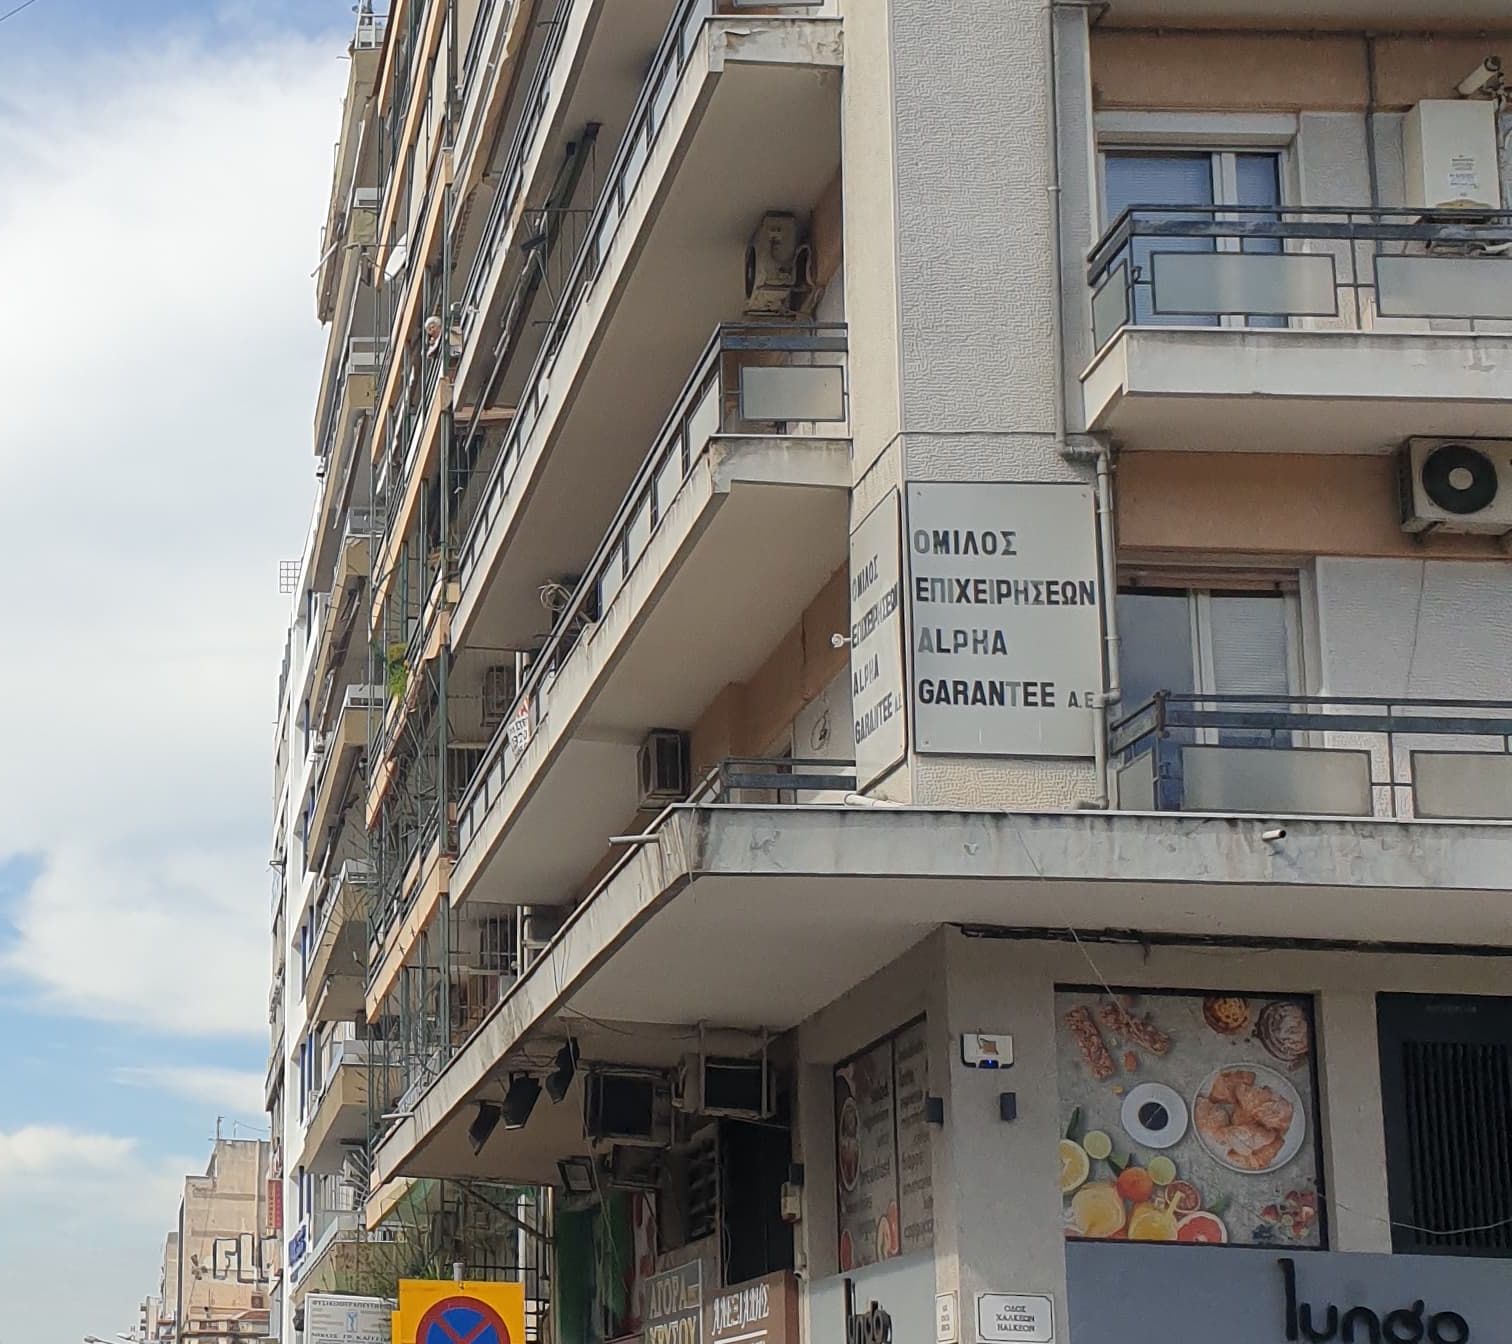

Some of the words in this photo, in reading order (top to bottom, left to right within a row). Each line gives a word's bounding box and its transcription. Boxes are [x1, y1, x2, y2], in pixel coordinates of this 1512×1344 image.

[913, 529, 1018, 556] ΟΜΙΛΟΣ
[915, 576, 1096, 606] ΕΠΙΧΕΙΡΗΣΕΩΝ
[917, 628, 1008, 656] ALPHA
[918, 678, 1055, 707] GARANTEE
[650, 1273, 688, 1319] ΑΓΟΡΑ
